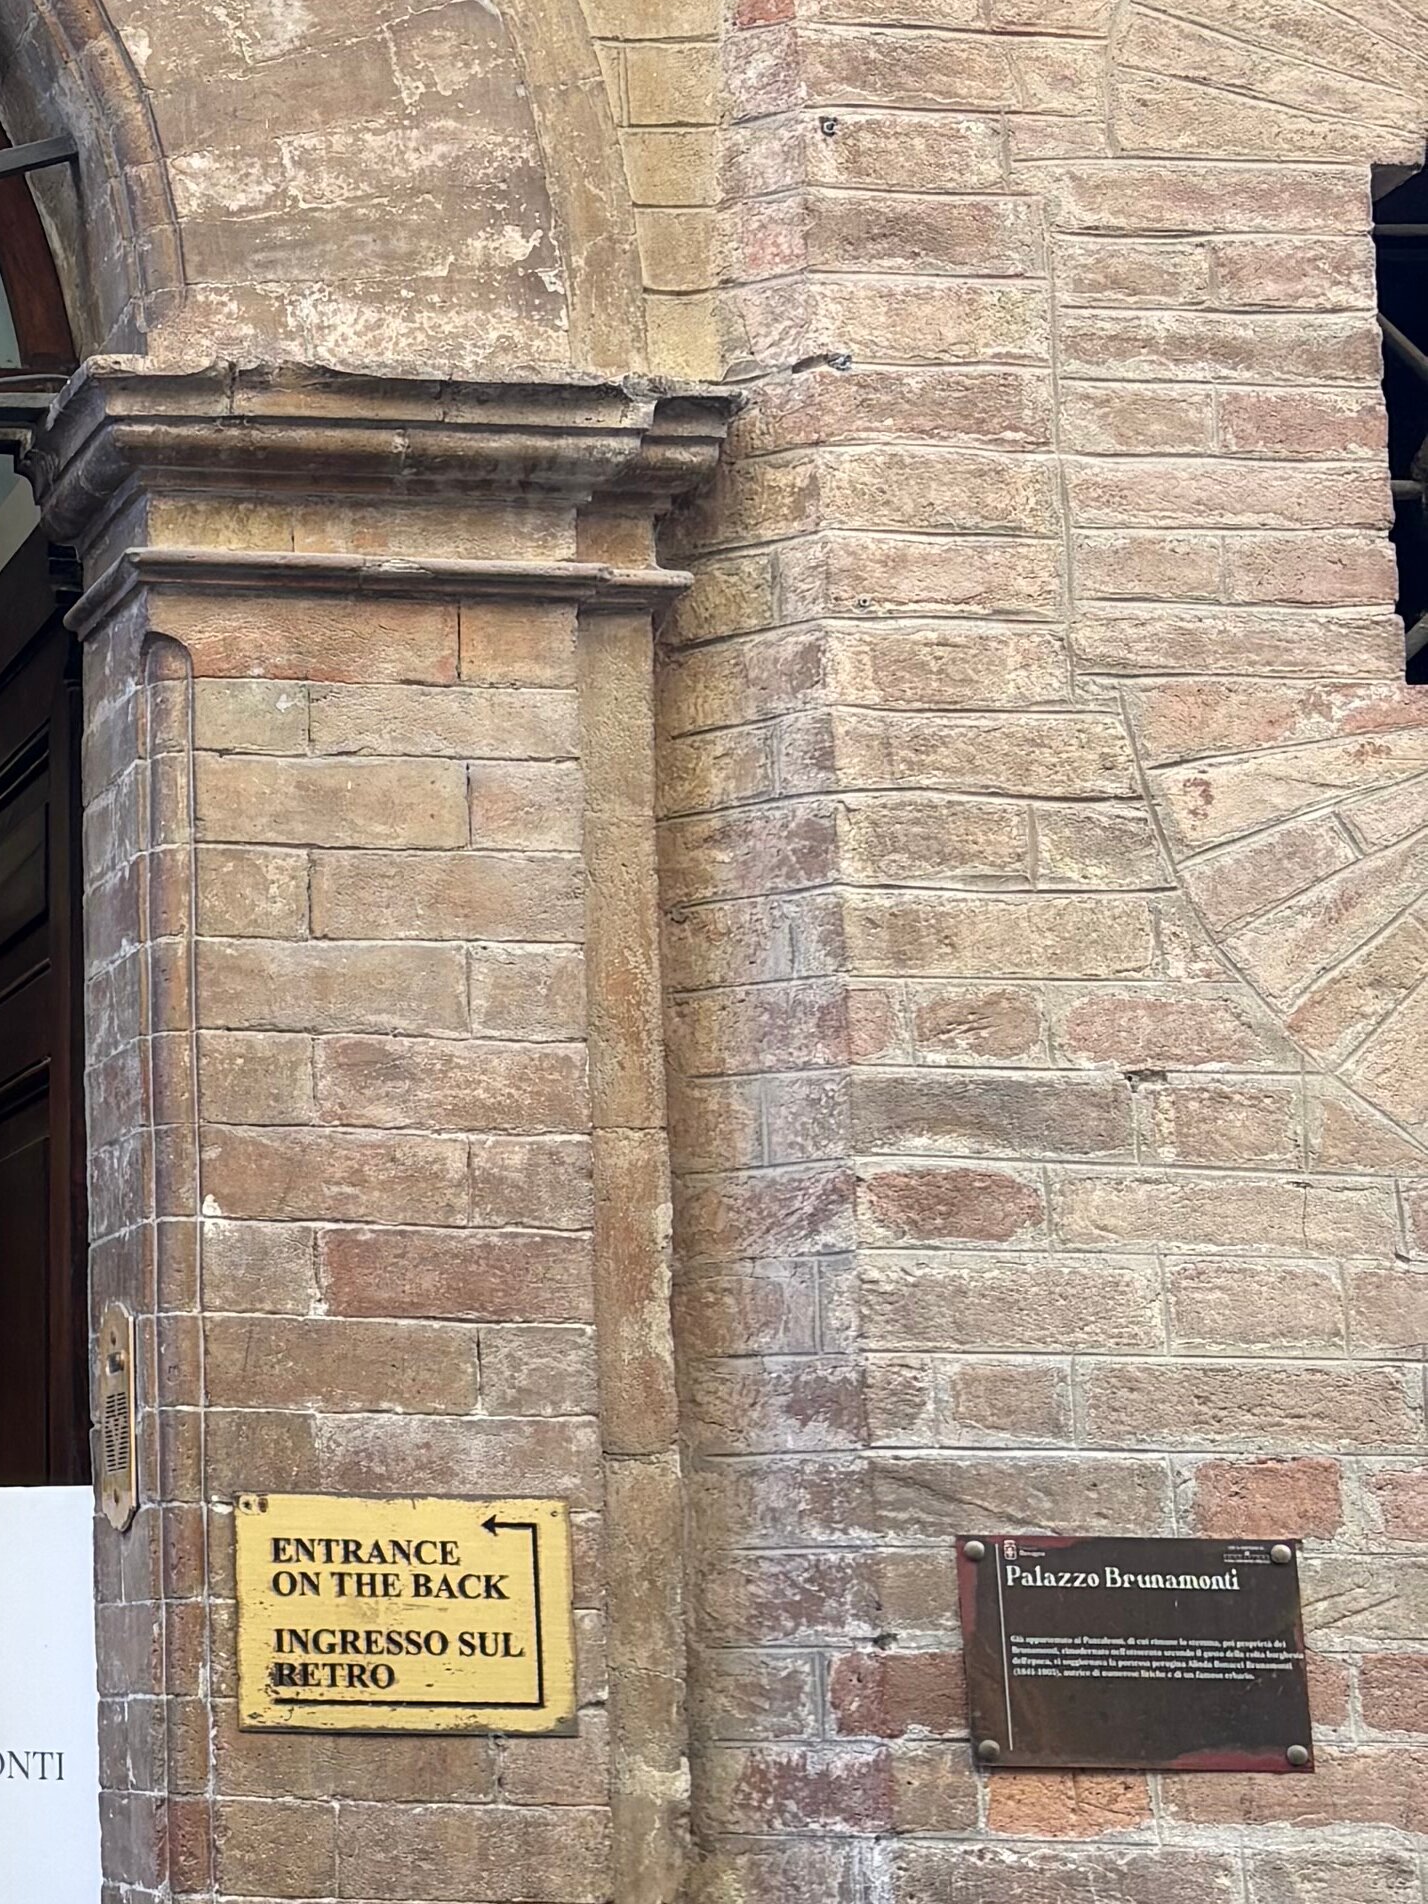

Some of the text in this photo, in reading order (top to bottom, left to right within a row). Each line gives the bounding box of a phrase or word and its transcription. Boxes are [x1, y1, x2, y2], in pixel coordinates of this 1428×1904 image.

[272, 1538, 461, 1566] ENTRANCE
[272, 1571, 510, 1599] ON THE BACK
[1005, 1566, 1240, 1590] Palazzo Brunamonti
[273, 1629, 525, 1658] INGRESSO SUL
[273, 1663, 395, 1689] RETRO
